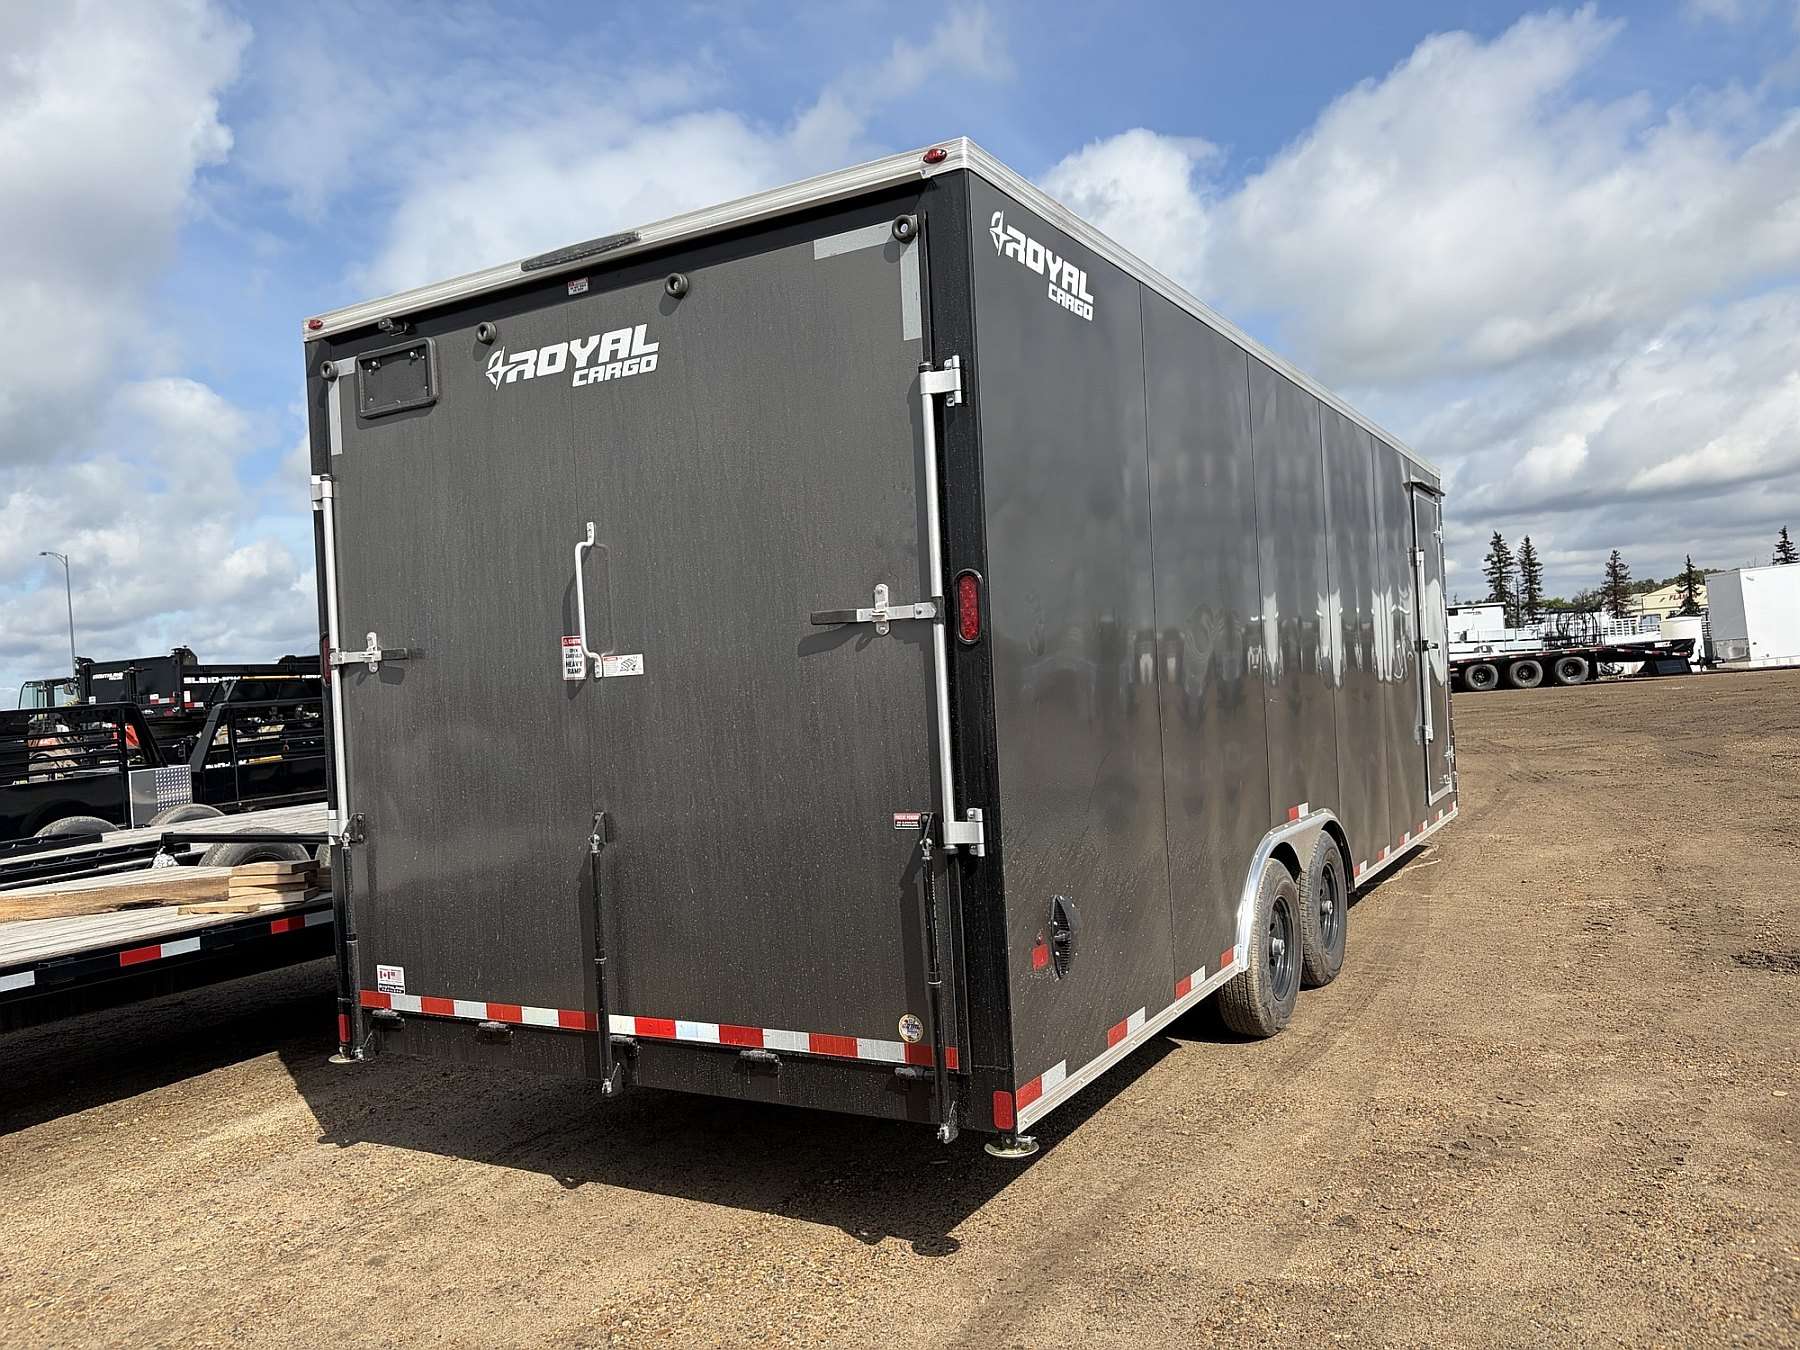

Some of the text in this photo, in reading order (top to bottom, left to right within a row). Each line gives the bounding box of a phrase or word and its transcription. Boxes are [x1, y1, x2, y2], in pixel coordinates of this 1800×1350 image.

[1005, 224, 1094, 304] ROYAL
[1048, 282, 1094, 321] CARGO
[505, 323, 660, 384] ROYAL
[572, 354, 659, 388] CARGO
